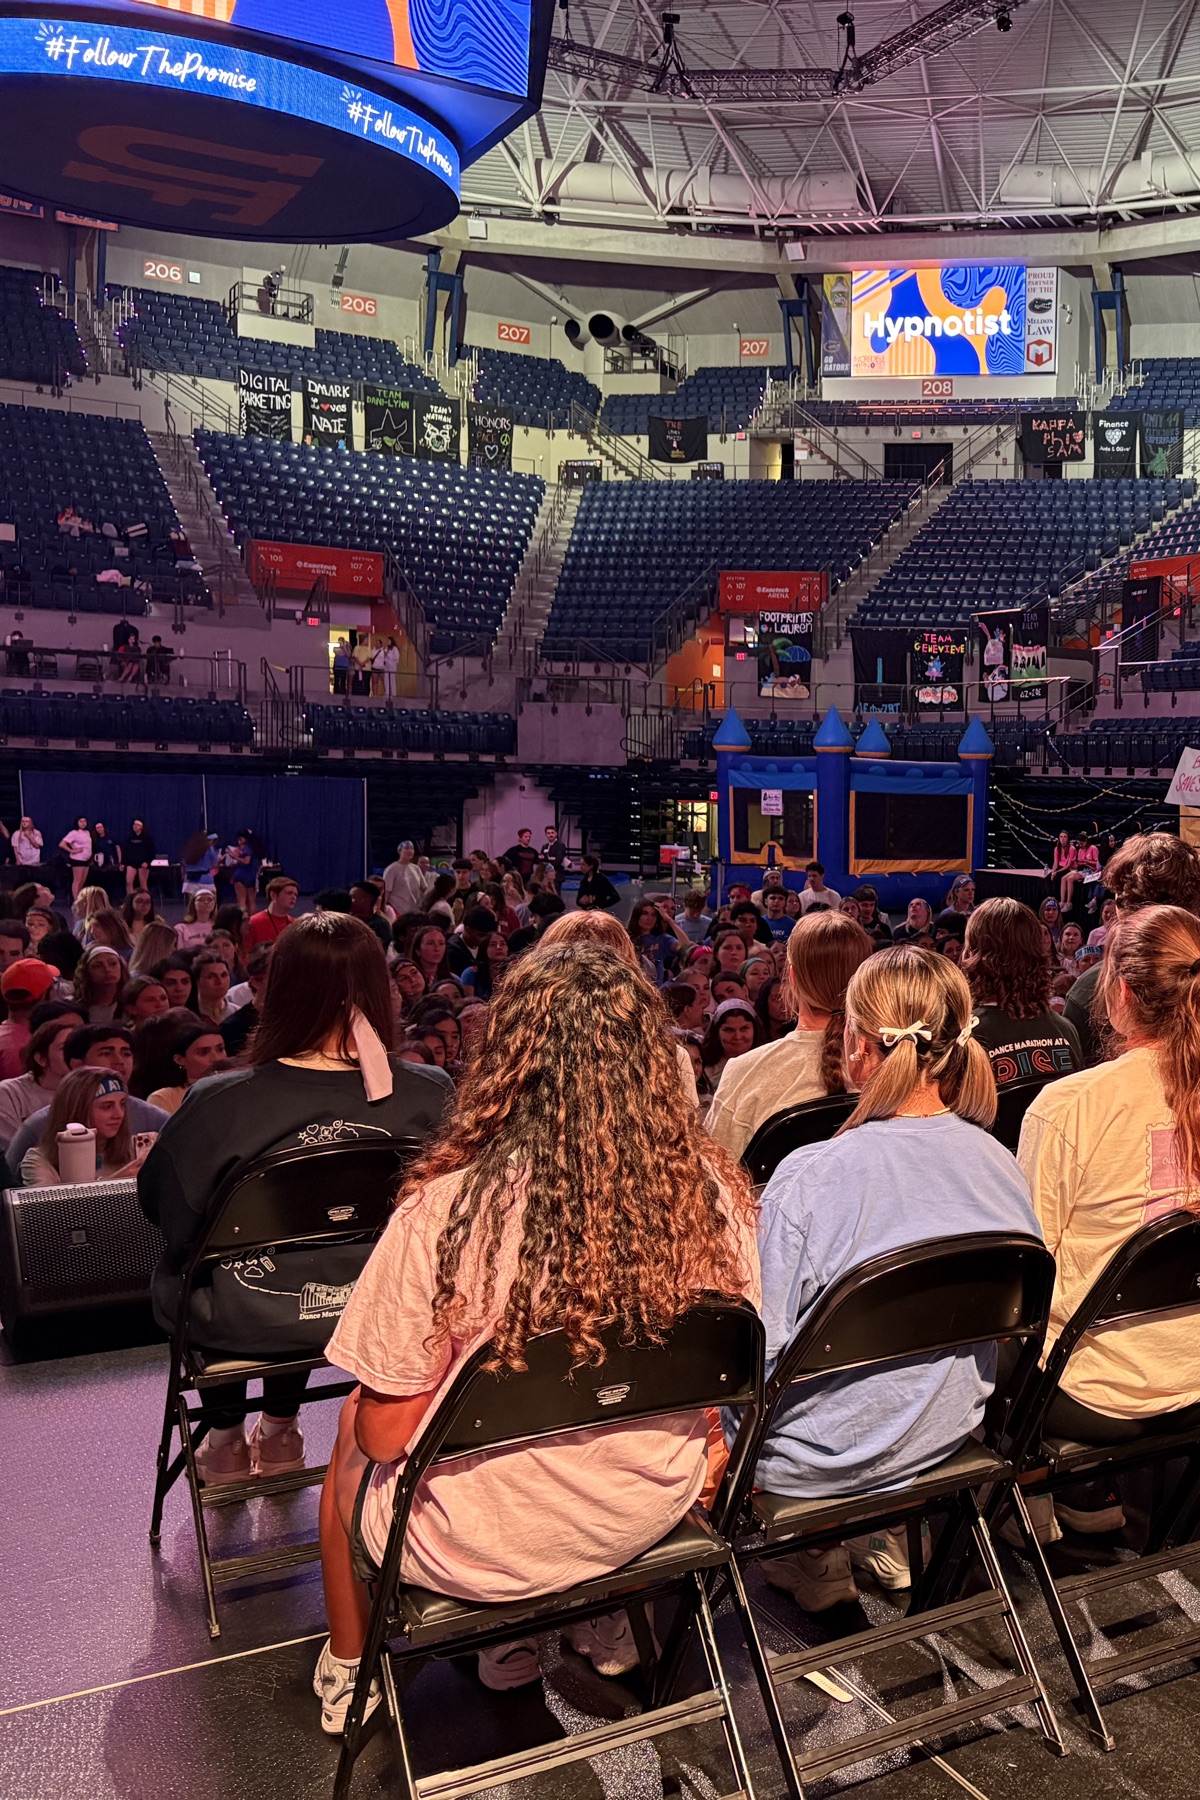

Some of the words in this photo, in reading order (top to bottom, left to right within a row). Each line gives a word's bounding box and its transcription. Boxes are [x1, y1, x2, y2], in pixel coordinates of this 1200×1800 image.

[45, 35, 257, 93] #FollowThePromise
[347, 99, 453, 177] #FollowThePromise
[144, 261, 182, 281] 206
[1028, 272, 1054, 280] PROUD
[343, 296, 376, 315] 206
[499, 324, 529, 343] 207
[864, 309, 1011, 343] Hypnotist
[742, 340, 768, 356] 207
[824, 363, 850, 372] GATORS
[240, 369, 290, 392] DIGITAL
[923, 381, 952, 395] 208
[307, 380, 350, 398] DMARK
[376, 389, 402, 398] TEAM
[240, 388, 291, 410] MARKETING
[429, 405, 448, 414] TEAM
[312, 414, 347, 433] NATE
[475, 415, 511, 431] HONORS
[1032, 419, 1076, 430] KAPPA
[1099, 419, 1129, 428] Finance
[270, 554, 283, 562] 105
[351, 562, 362, 570] 107
[923, 633, 952, 643] TEAM
[914, 642, 965, 655] GENEVIEVE
[989, 1043, 1015, 1059] DANCE
[1015, 1038, 1053, 1051] MARATHON
[1054, 1037, 1063, 1046] AT
[108, 1079, 121, 1091] AT
[299, 1312, 320, 1321] Dance
